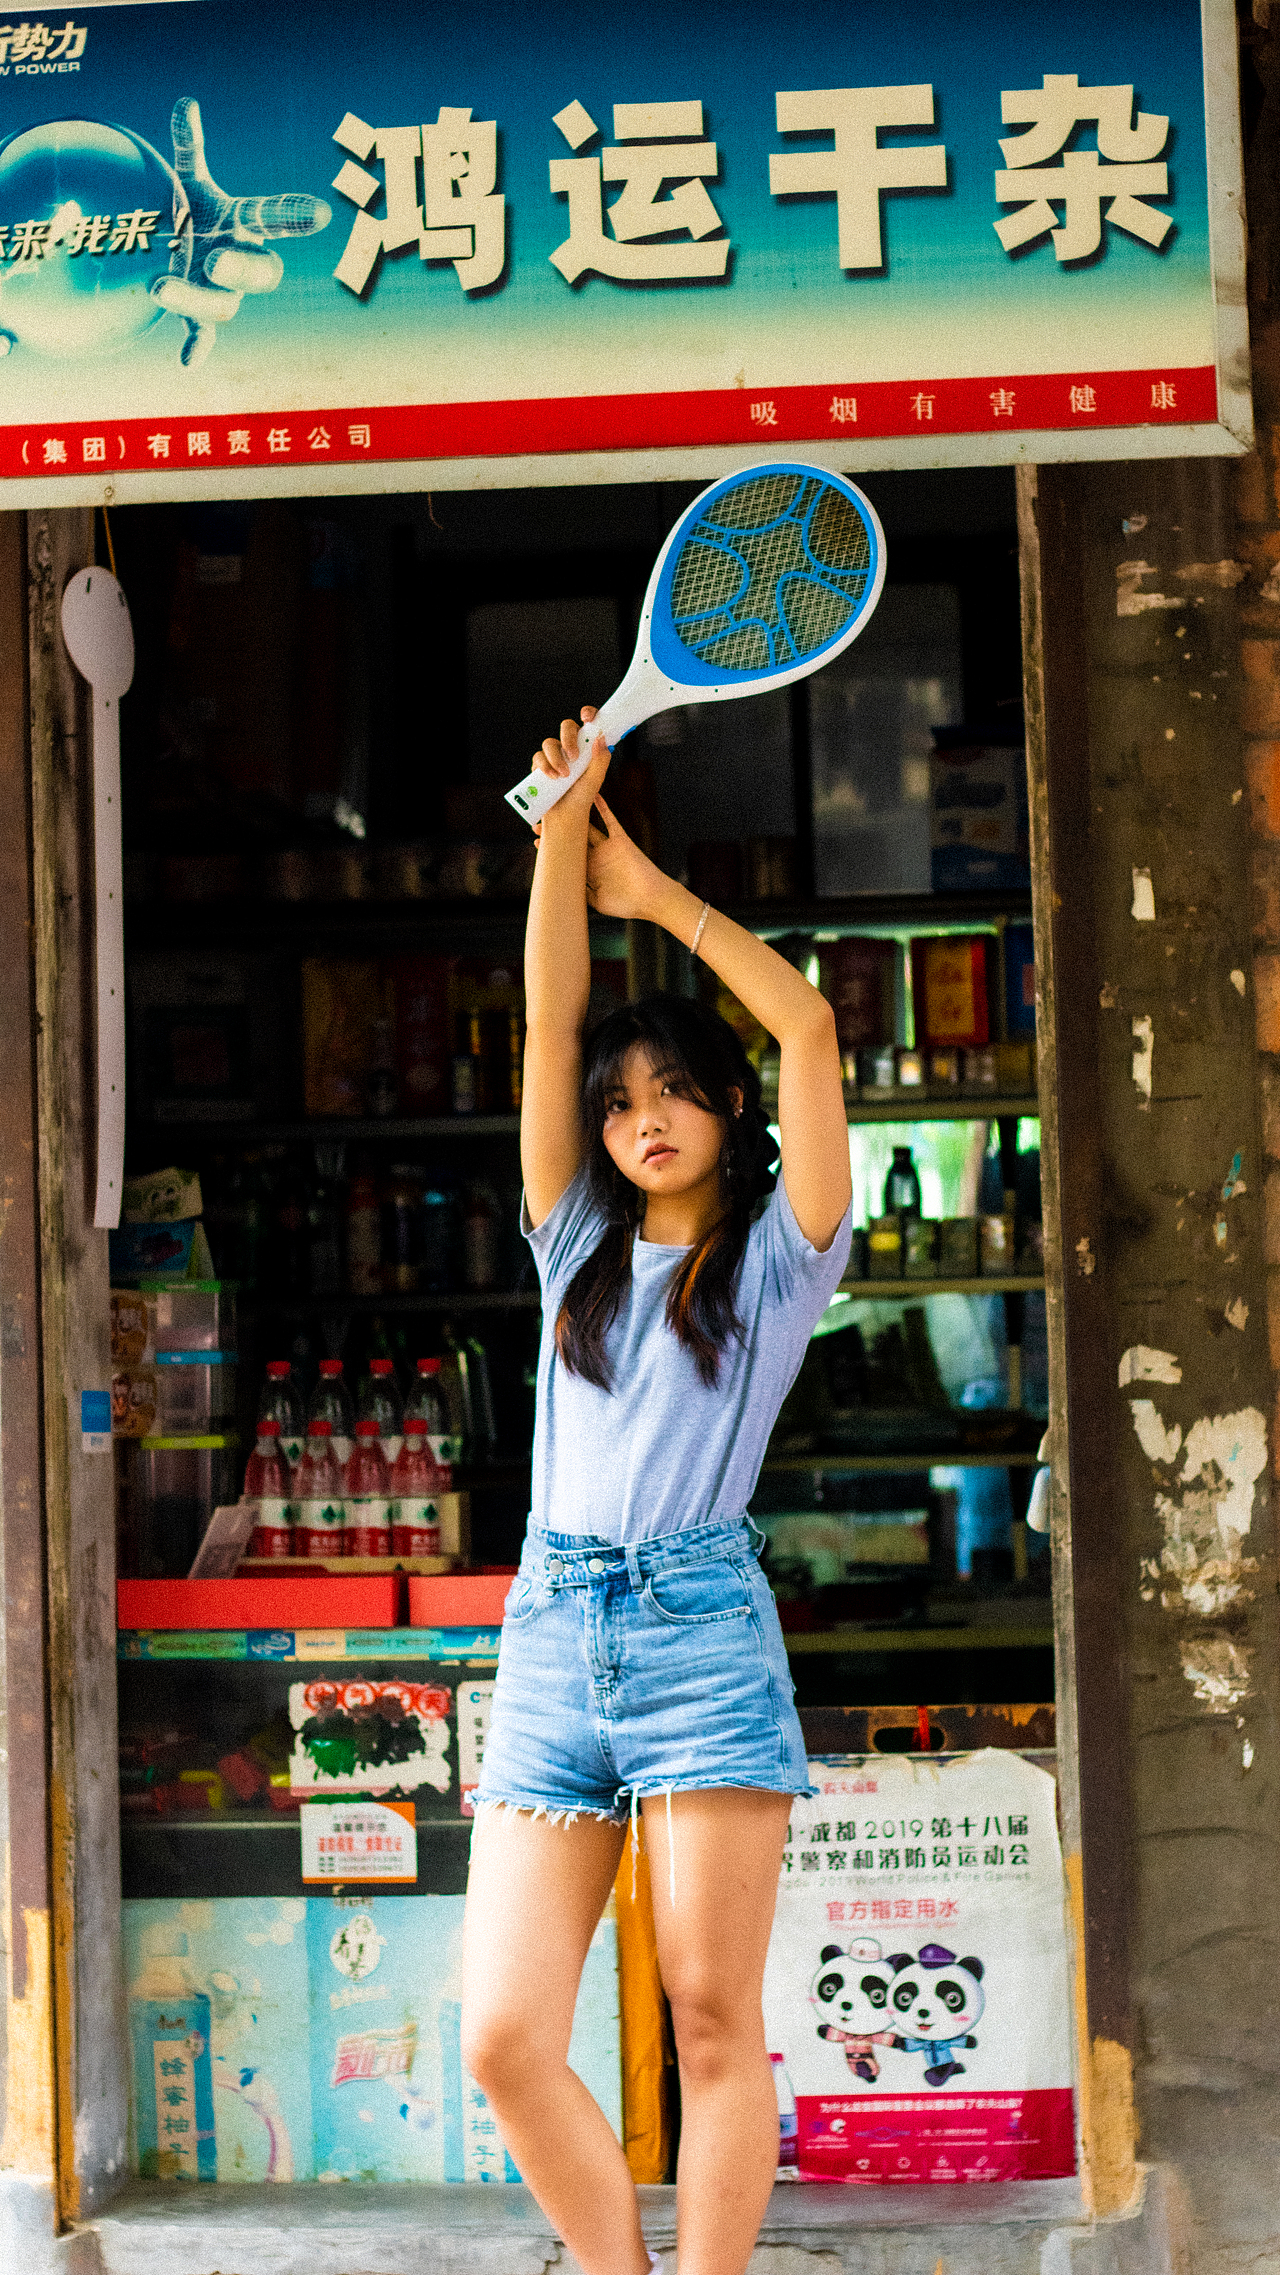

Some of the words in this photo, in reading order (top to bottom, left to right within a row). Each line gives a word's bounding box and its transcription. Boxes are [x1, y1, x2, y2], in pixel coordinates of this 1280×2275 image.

[15, 61, 81, 75] POWER
[332, 74, 1174, 297] 鸿运干杂
[750, 380, 1178, 427] 吸烟有害健康
[826, 1897, 959, 1922] 官方指定用水
